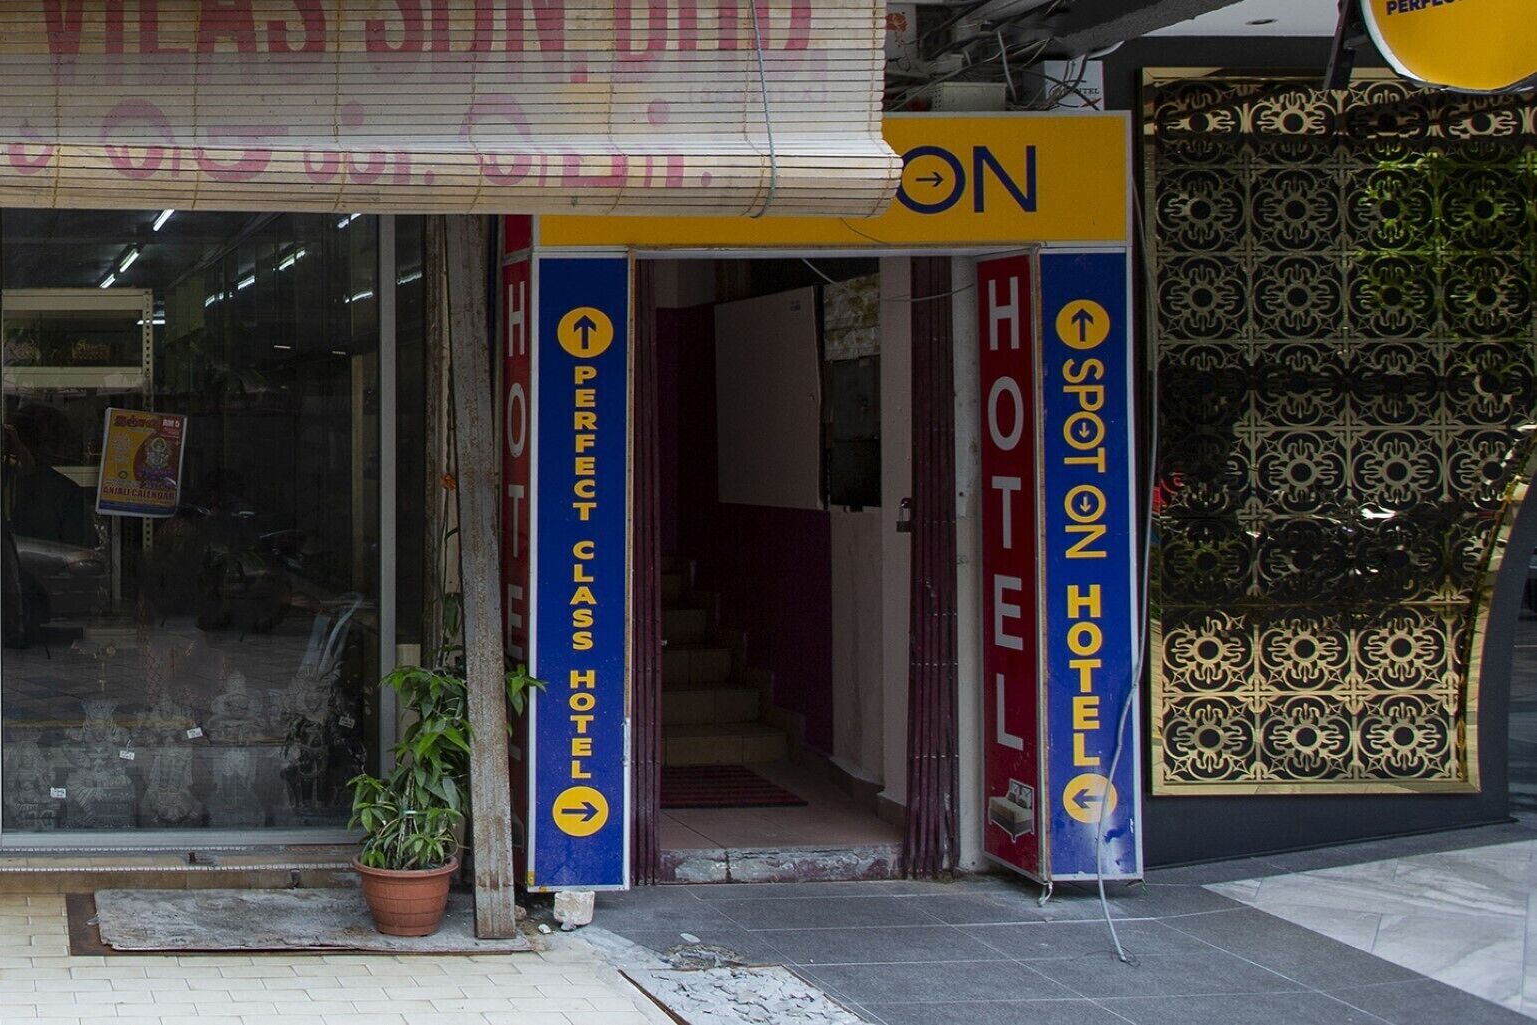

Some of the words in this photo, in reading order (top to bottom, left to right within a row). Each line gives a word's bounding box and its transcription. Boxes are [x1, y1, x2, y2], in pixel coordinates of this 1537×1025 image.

[897, 144, 1038, 214] ON
[570, 366, 597, 521] PERFECT
[1062, 358, 1106, 474] SPOT
[986, 276, 1024, 750] HOTEL
[1064, 488, 1107, 560] ON
[570, 541, 597, 651] CLASS
[570, 669, 597, 780] HOTEL
[1066, 583, 1103, 766] HOTEL
